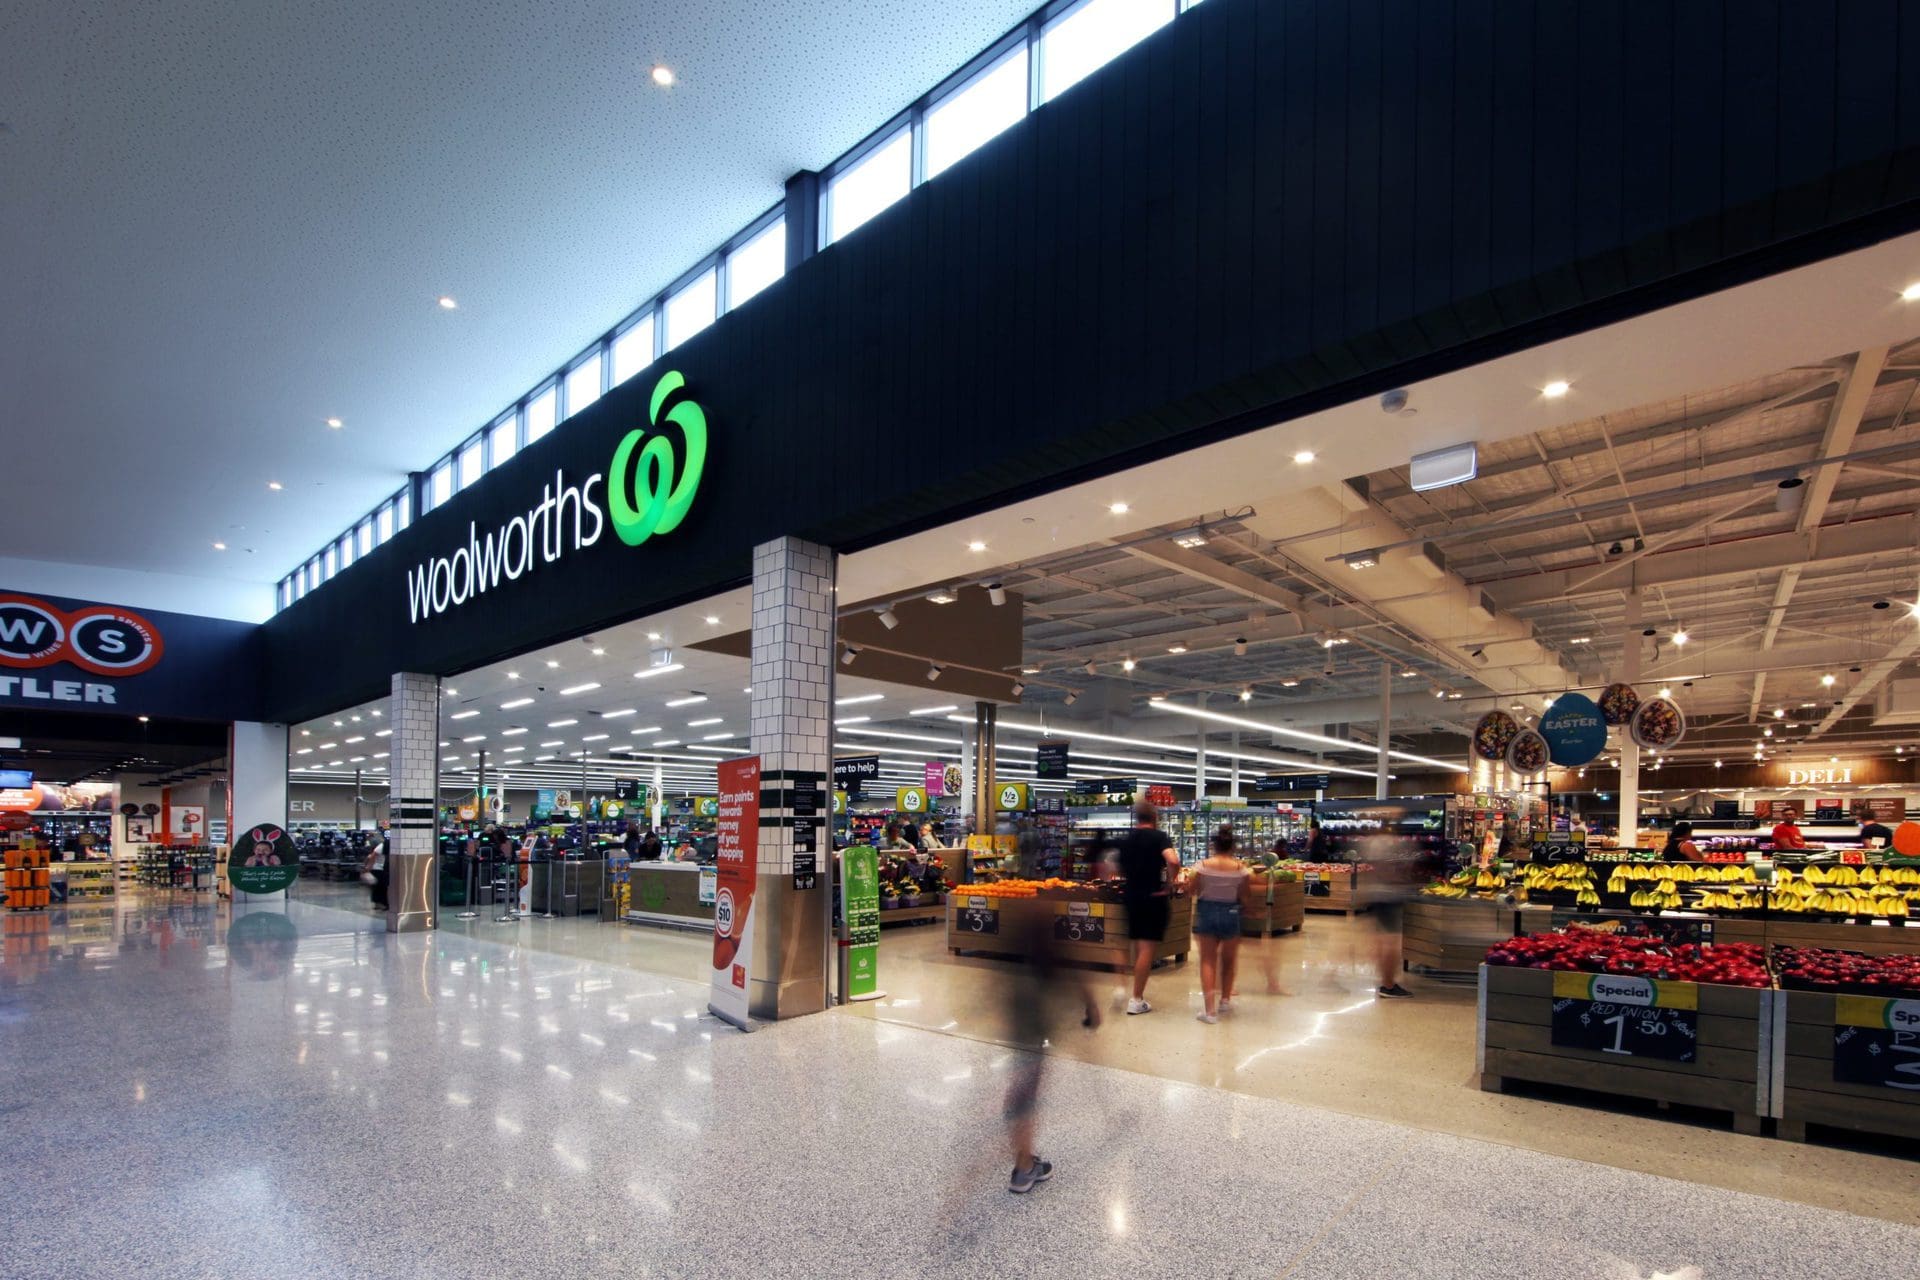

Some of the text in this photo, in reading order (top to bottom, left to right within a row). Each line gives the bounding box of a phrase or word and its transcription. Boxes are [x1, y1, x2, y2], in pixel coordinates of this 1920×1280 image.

[408, 468, 603, 624] woolworths
[0, 617, 126, 654] W S
[115, 616, 152, 643] SPIRITS
[32, 641, 63, 659] WINE
[0, 676, 117, 704] TLER
[1545, 717, 1598, 730] EASTER
[848, 764, 857, 773] to
[857, 762, 875, 774] help
[1788, 768, 1852, 785] DELI
[1004, 790, 1016, 800] 1/2
[1102, 785, 1109, 793] 2
[720, 790, 754, 805] Earn points
[907, 794, 918, 803] 1/2
[290, 800, 315, 812] ER
[719, 805, 743, 817] towards
[719, 821, 739, 834] money
[718, 832, 726, 844] of
[717, 846, 744, 862] shopping
[1548, 845, 1563, 861] 2
[718, 907, 731, 922] $10
[971, 913, 984, 932] 3
[1068, 922, 1082, 941] 3
[1596, 984, 1650, 998] Special
[1588, 1002, 1616, 1015] RED
[1620, 1004, 1662, 1021] ONION
[1601, 1015, 1633, 1055] 1
